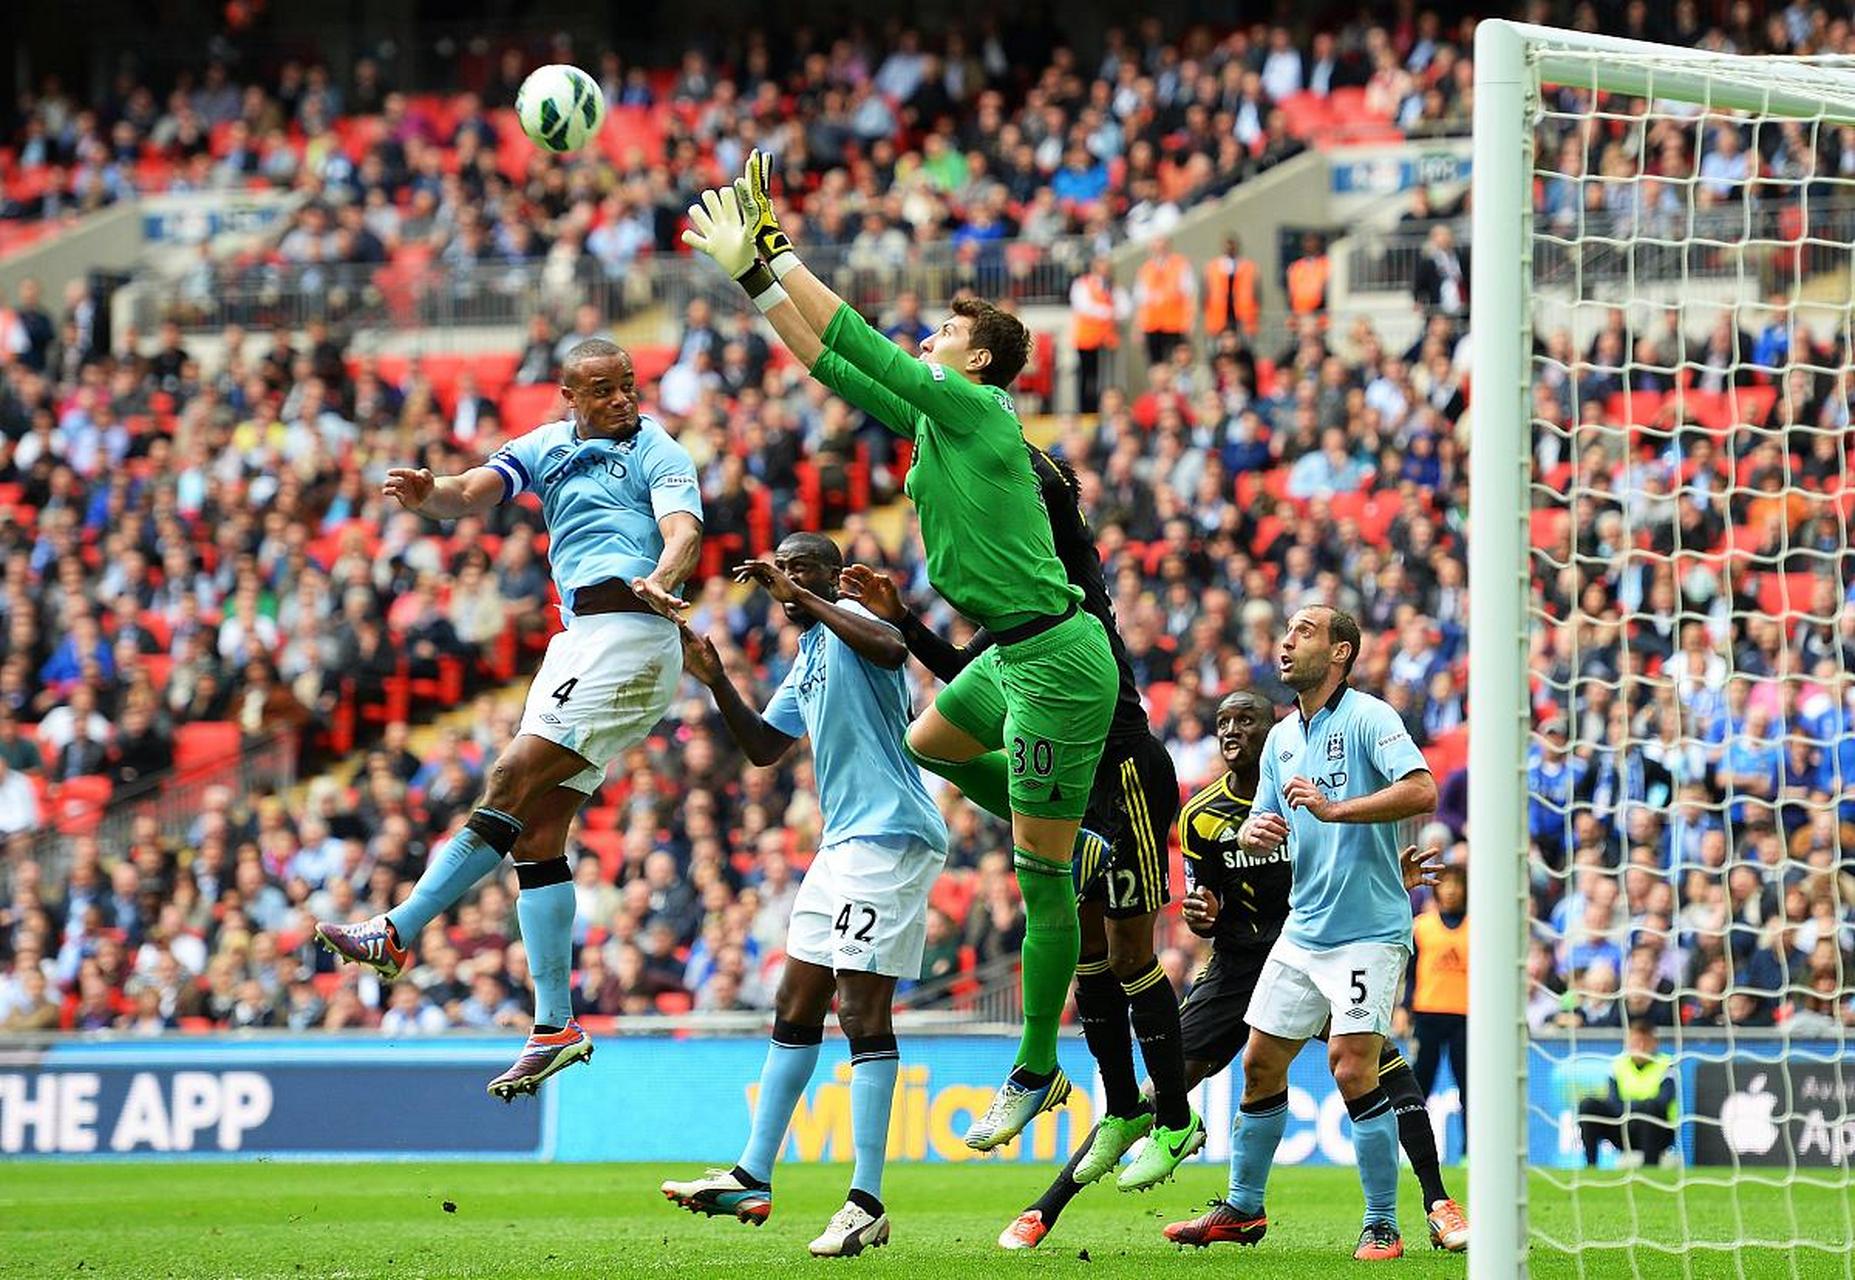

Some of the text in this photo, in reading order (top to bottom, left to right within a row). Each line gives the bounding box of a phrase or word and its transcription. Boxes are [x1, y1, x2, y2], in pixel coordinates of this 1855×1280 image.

[552, 677, 579, 709] 4
[1013, 736, 1054, 777] 30
[1105, 869, 1140, 909] 12
[835, 903, 877, 943] 42
[1350, 969, 1368, 1005] 5
[0, 1072, 273, 1152] HE APP
